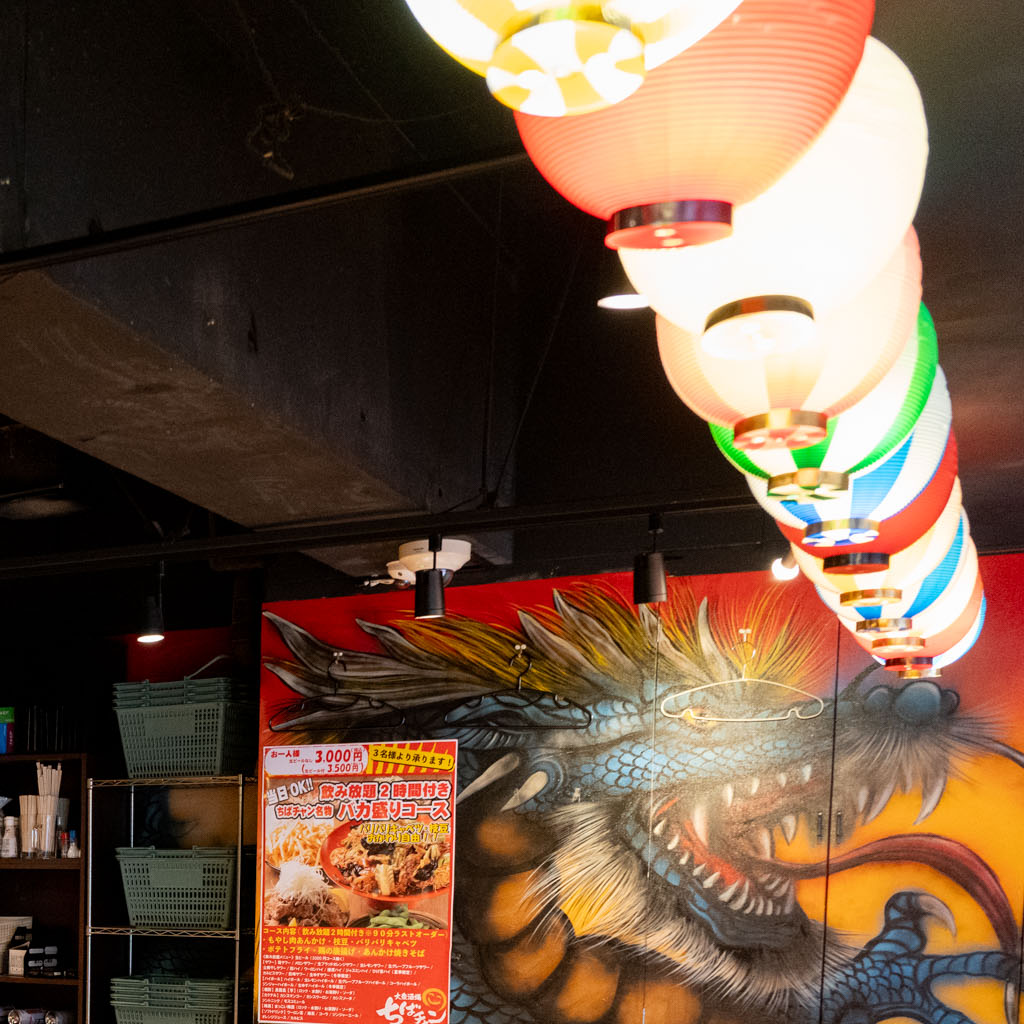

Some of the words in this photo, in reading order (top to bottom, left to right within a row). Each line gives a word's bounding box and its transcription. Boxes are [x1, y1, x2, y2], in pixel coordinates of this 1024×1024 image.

[320, 782, 451, 799] 飲み放題2時間付き
[276, 804, 334, 818] ちばチャン名物
[338, 801, 450, 820] バカ盛りコース
